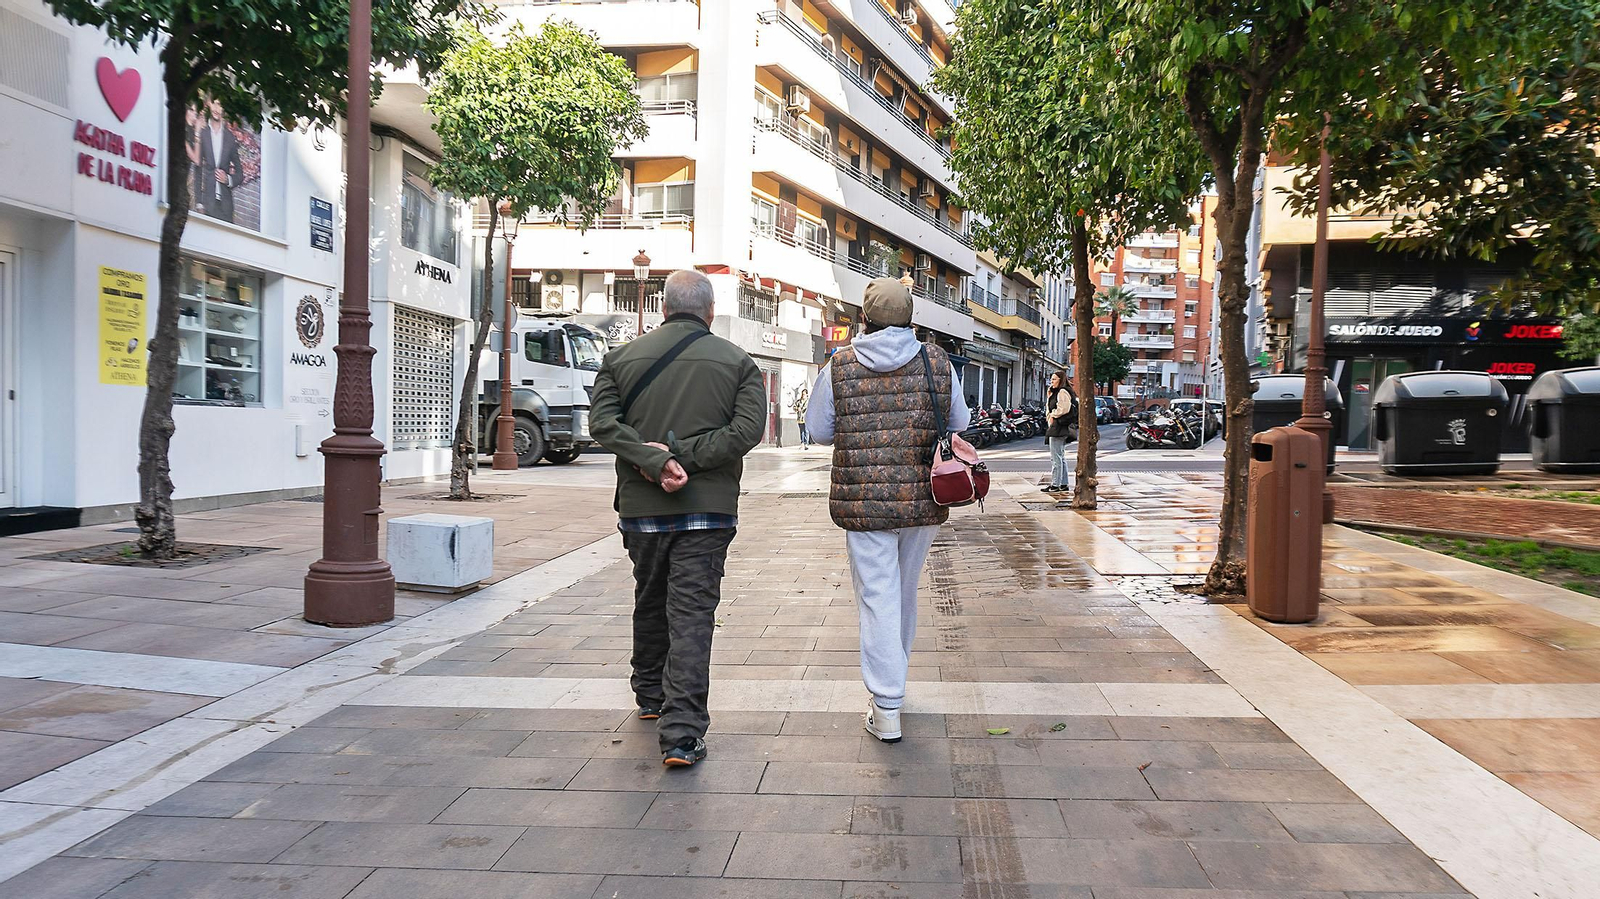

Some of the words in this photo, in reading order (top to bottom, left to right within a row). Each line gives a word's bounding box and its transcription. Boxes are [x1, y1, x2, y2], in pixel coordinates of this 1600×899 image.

[74, 119, 126, 158] AGATHA
[130, 140, 157, 168] RUIZ
[78, 152, 95, 177] DE
[98, 158, 115, 184] LA
[118, 164, 152, 195] PRADA
[103, 267, 144, 282] COMPRAMOS
[414, 260, 452, 284] ATHENA
[116, 279, 130, 288] ORO
[1329, 322, 1375, 336] SALÓN
[1376, 325, 1396, 336] DE
[1395, 325, 1443, 336] JUEGO
[1504, 325, 1563, 338] JOKER
[290, 352, 327, 367] AMAGOA
[1486, 363, 1536, 374] JOKER
